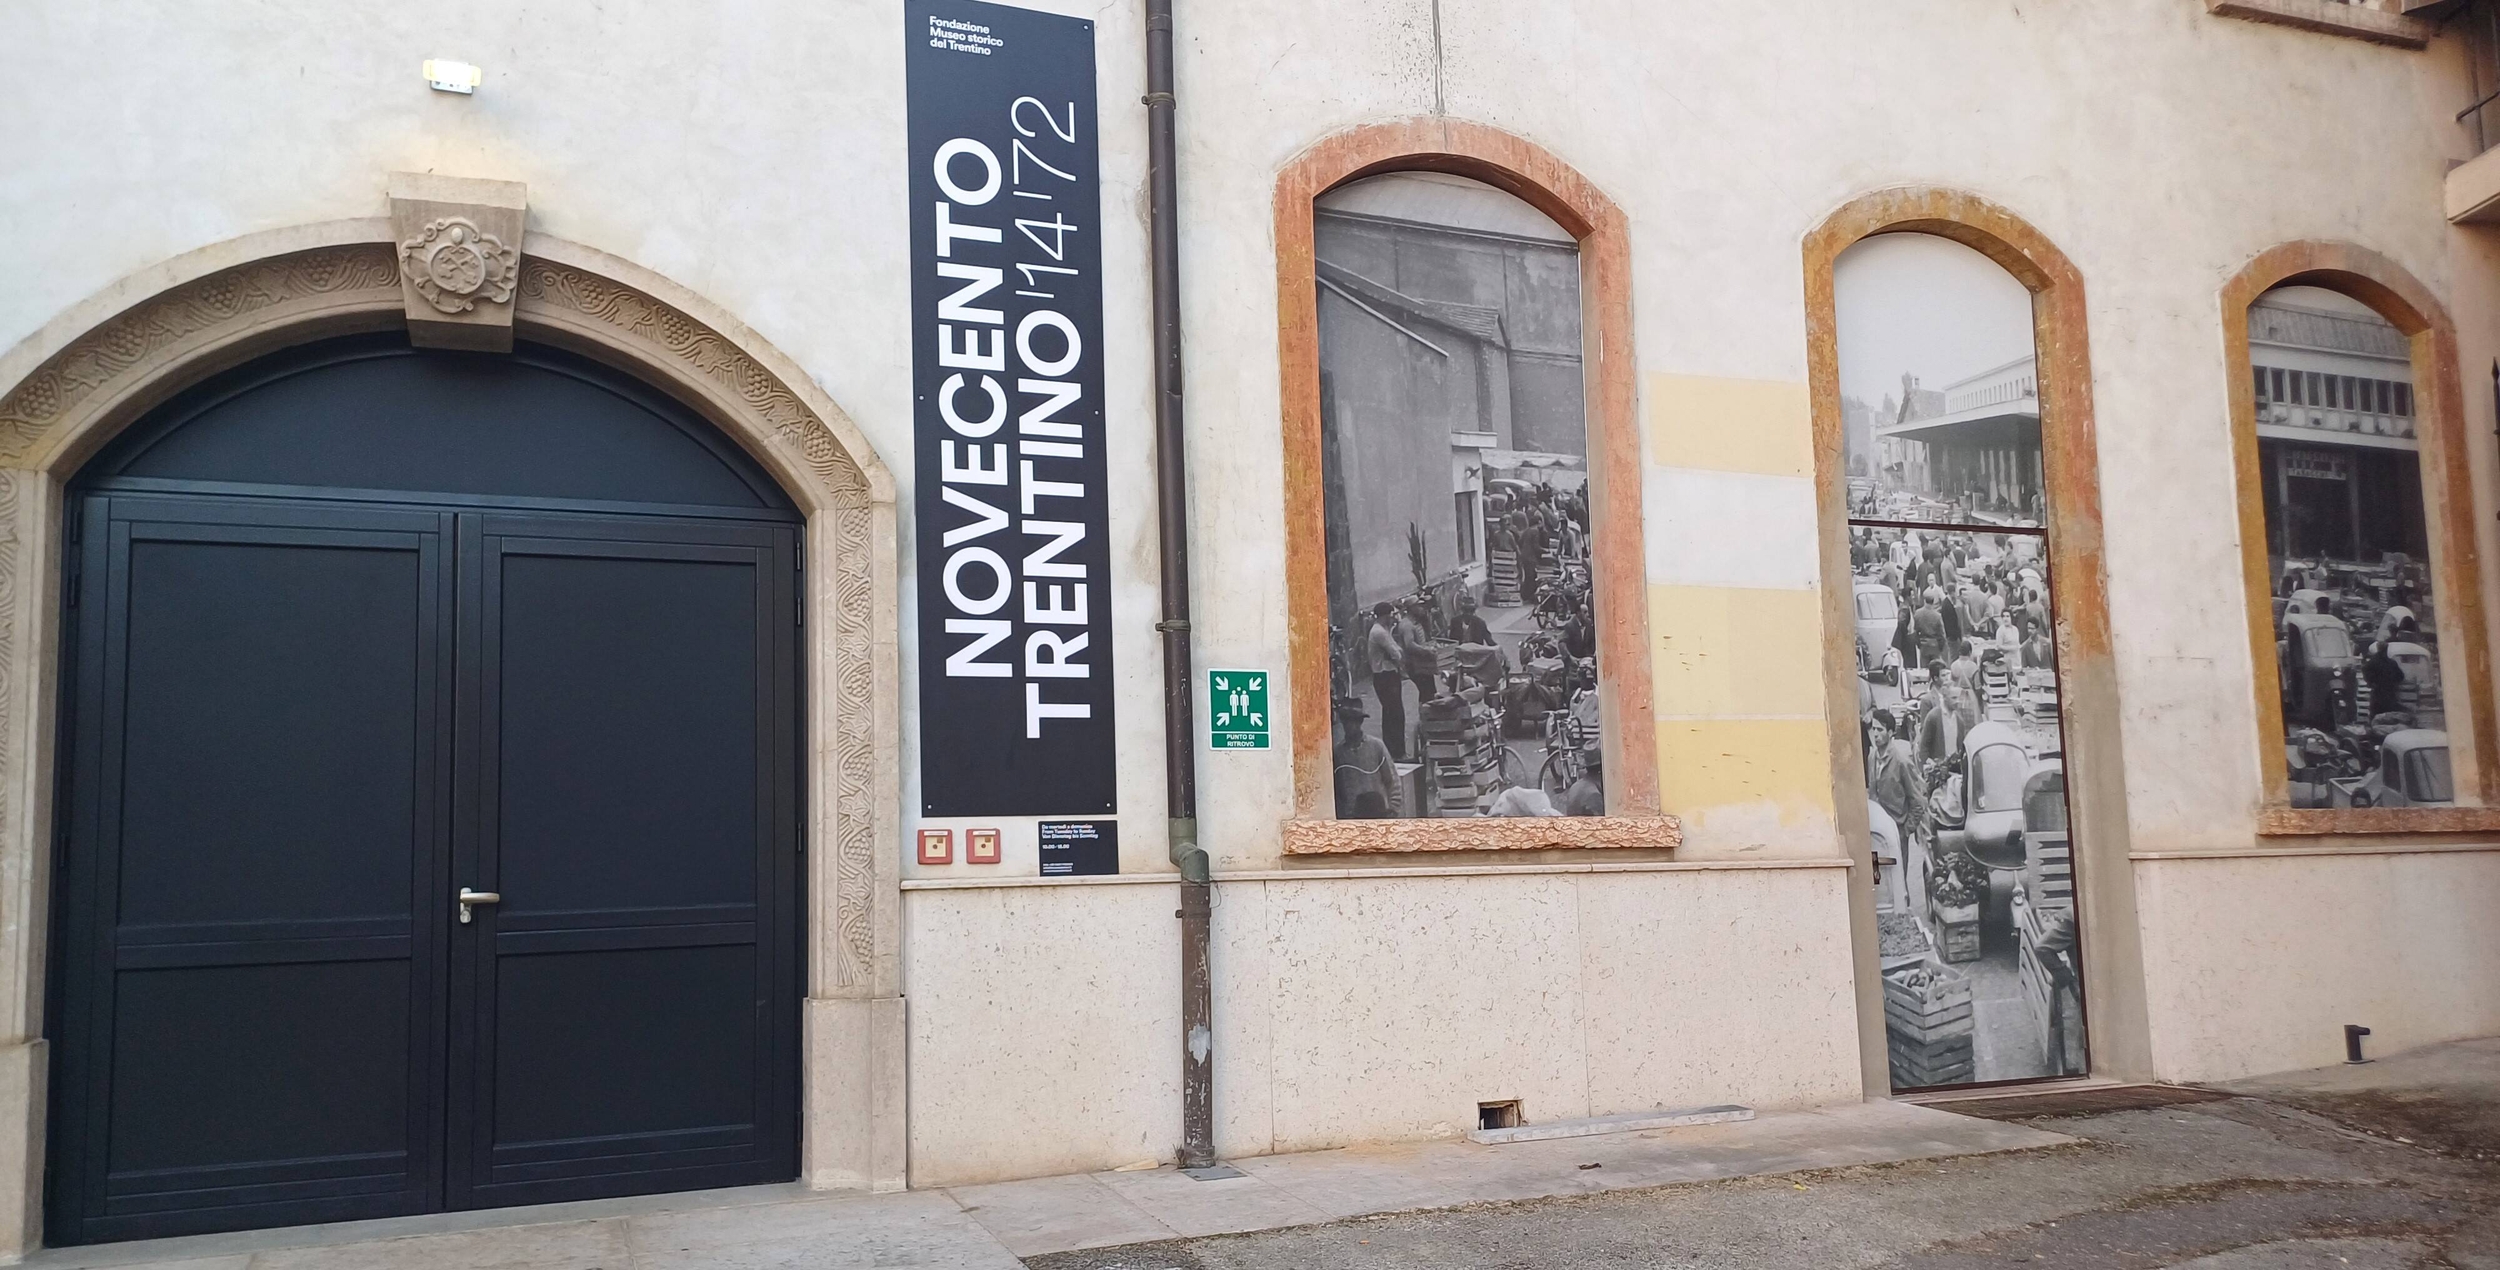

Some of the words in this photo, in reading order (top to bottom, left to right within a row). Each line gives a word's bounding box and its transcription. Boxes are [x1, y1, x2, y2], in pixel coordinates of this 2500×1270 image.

[929, 15, 990, 34] Fondazione
[929, 26, 966, 41] Museo
[967, 33, 1004, 47] storico
[929, 37, 947, 49] del
[949, 40, 991, 56] Trentino
[933, 137, 1013, 678] NOVECENTO
[1016, 309, 1091, 739] TRENTINO
